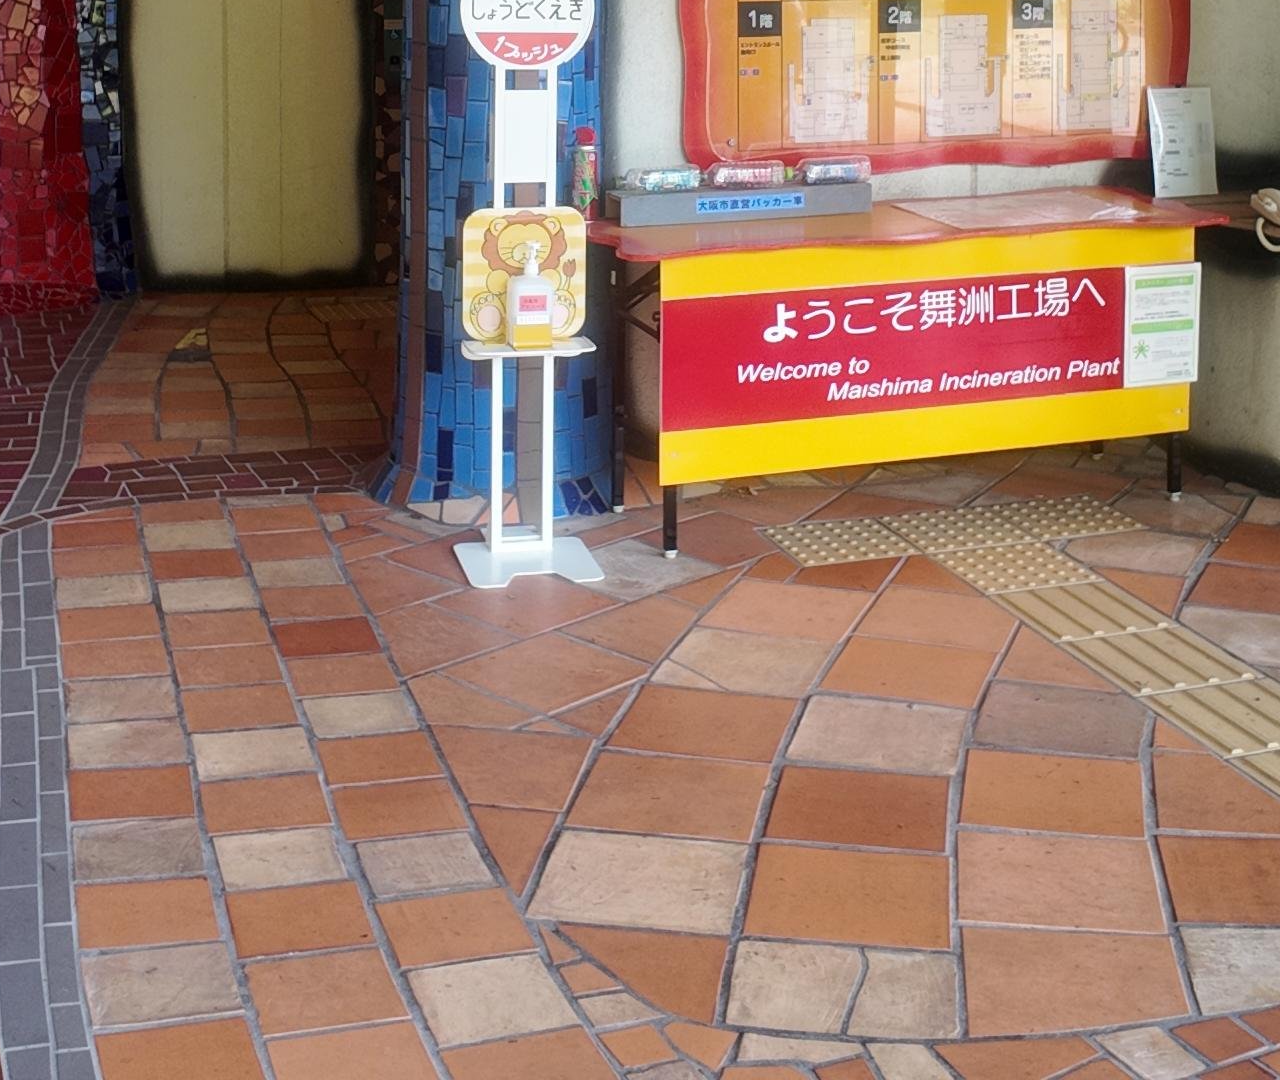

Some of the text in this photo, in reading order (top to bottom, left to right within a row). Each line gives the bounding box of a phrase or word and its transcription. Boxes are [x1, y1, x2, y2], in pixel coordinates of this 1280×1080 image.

[748, 9, 774, 29] 1階
[887, 5, 913, 25] 2階
[1021, 2, 1045, 21] 3階
[698, 195, 803, 212] 大阪市直営パッカー車
[763, 277, 1106, 343] ようこそ舞洲工場へ
[736, 356, 870, 384] Welcome to
[939, 363, 1062, 392] Incineration
[1067, 357, 1121, 379] Plant
